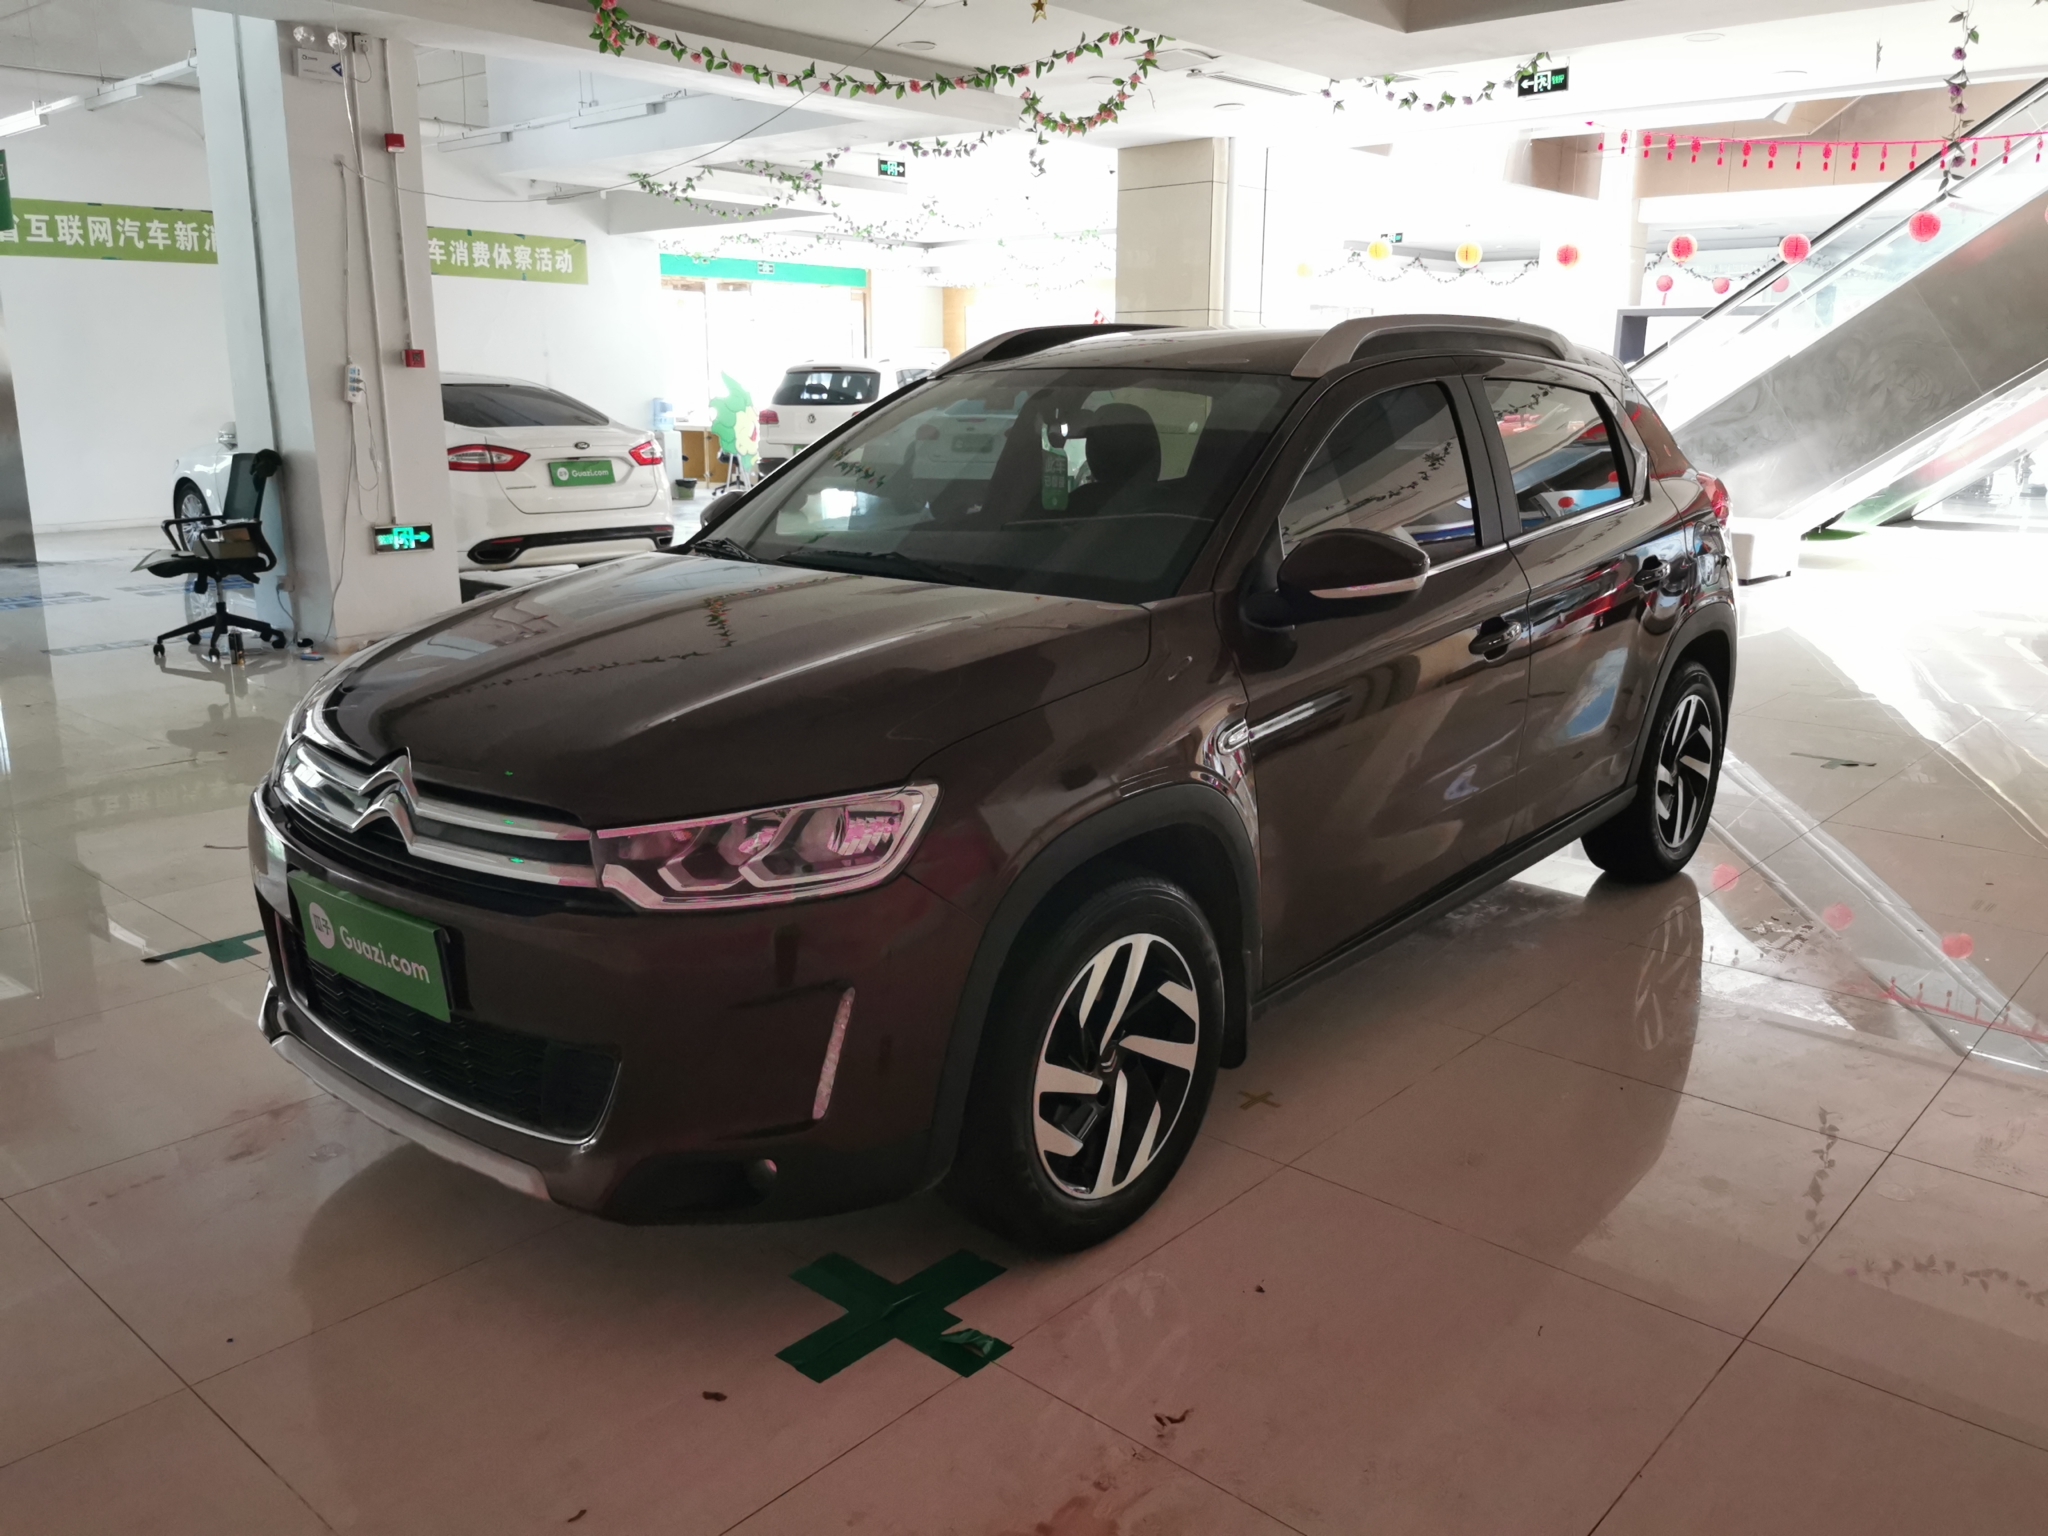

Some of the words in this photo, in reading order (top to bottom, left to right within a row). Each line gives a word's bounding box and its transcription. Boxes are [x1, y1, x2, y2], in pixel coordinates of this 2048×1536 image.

[428, 238, 573, 274] 车消费体察活动
[571, 468, 609, 478] Guazi.com
[312, 913, 332, 937] 瓜子
[339, 925, 430, 984] Guazi.com
